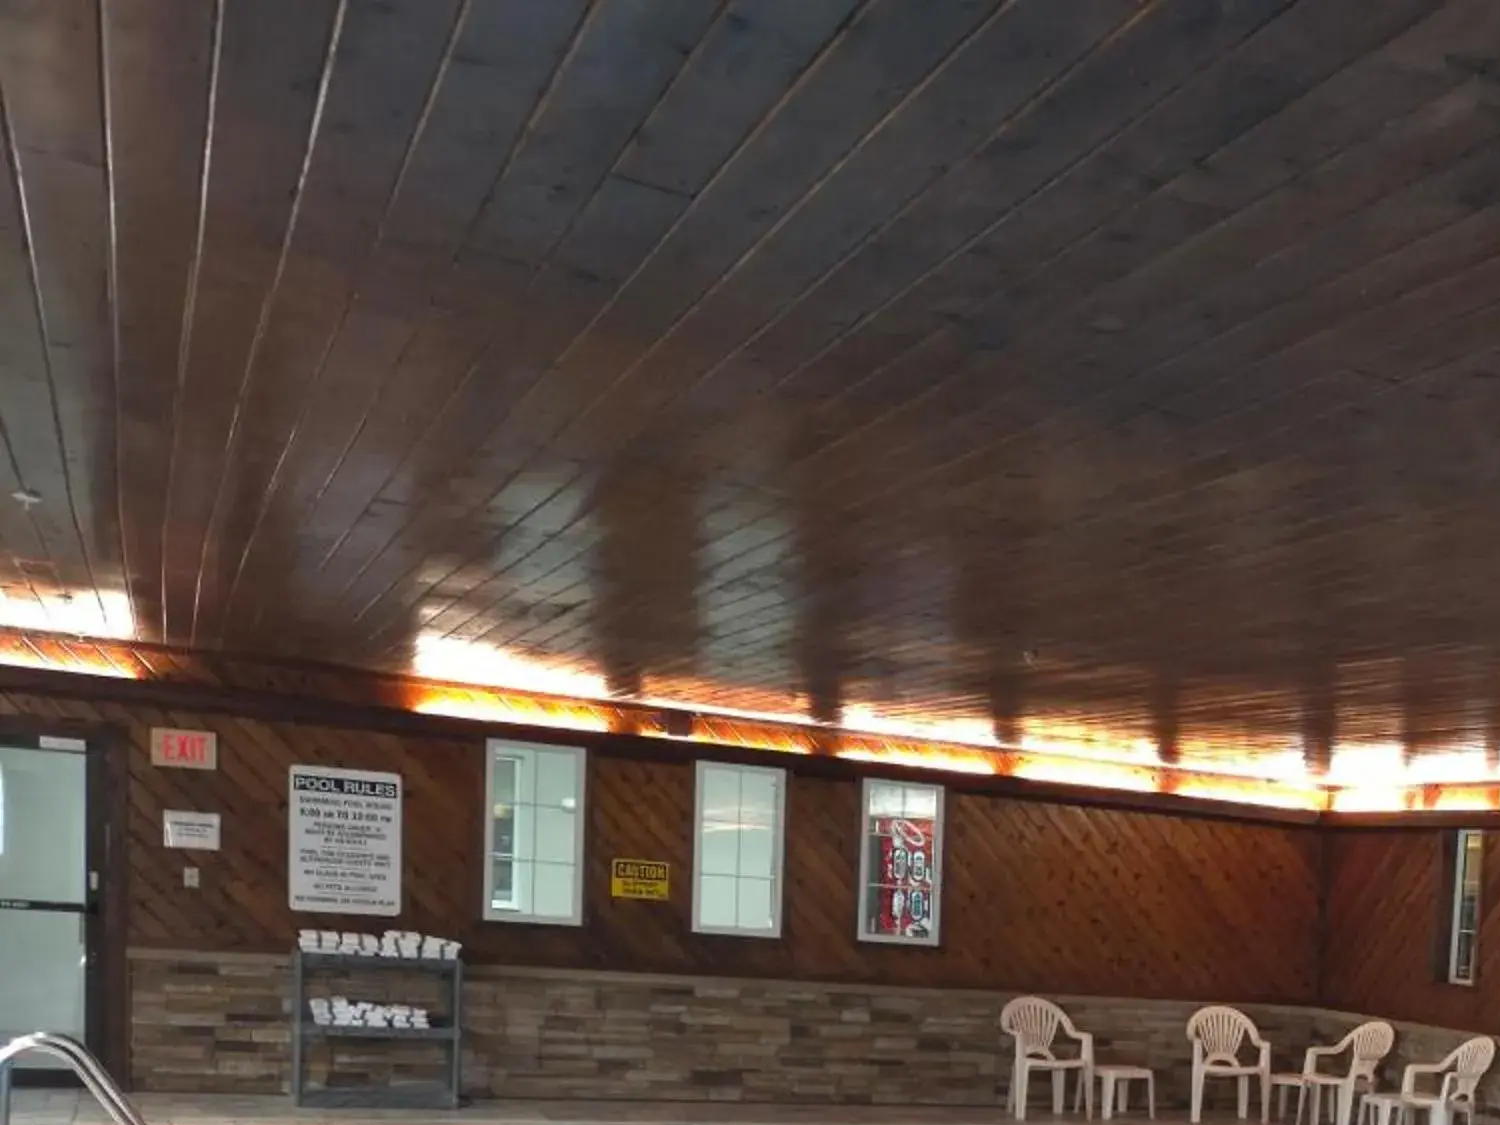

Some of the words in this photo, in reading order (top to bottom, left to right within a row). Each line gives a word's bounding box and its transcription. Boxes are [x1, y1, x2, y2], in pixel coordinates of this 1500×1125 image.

[163, 734, 207, 763] EXIT
[296, 777, 340, 792] POOL
[343, 781, 396, 798] RULES
